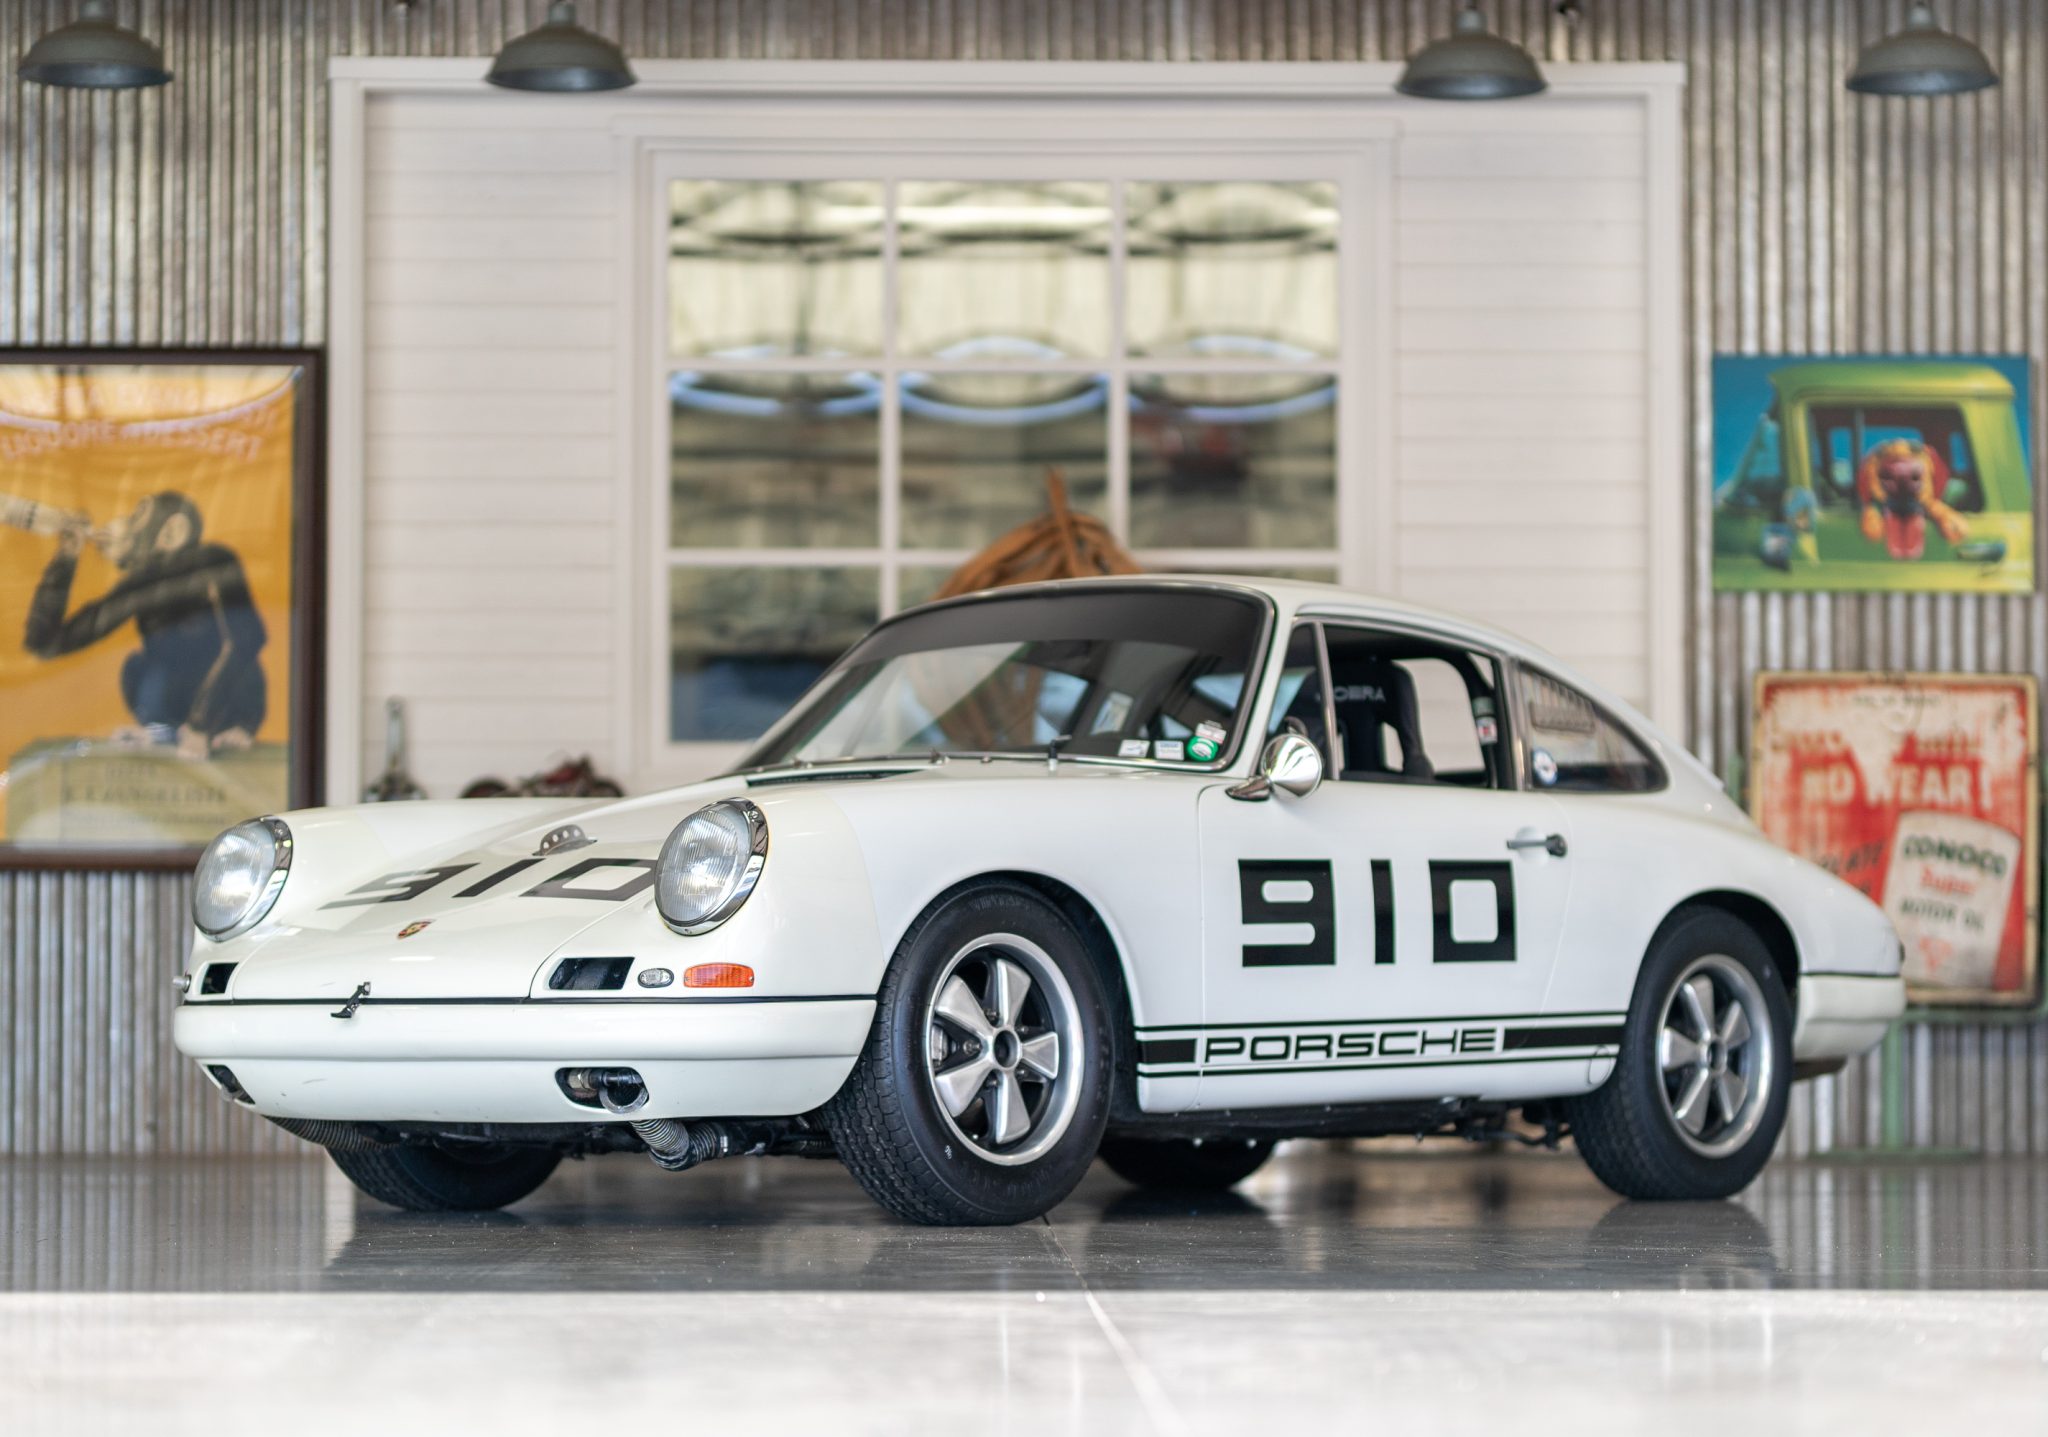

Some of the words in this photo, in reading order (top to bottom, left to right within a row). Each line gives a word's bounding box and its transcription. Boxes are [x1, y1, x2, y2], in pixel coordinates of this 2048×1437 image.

[1903, 834, 2007, 879] CONOCO
[316, 857, 656, 911] 910
[1238, 859, 1517, 967] 910
[1204, 1028, 1496, 1063] PORSCHE
